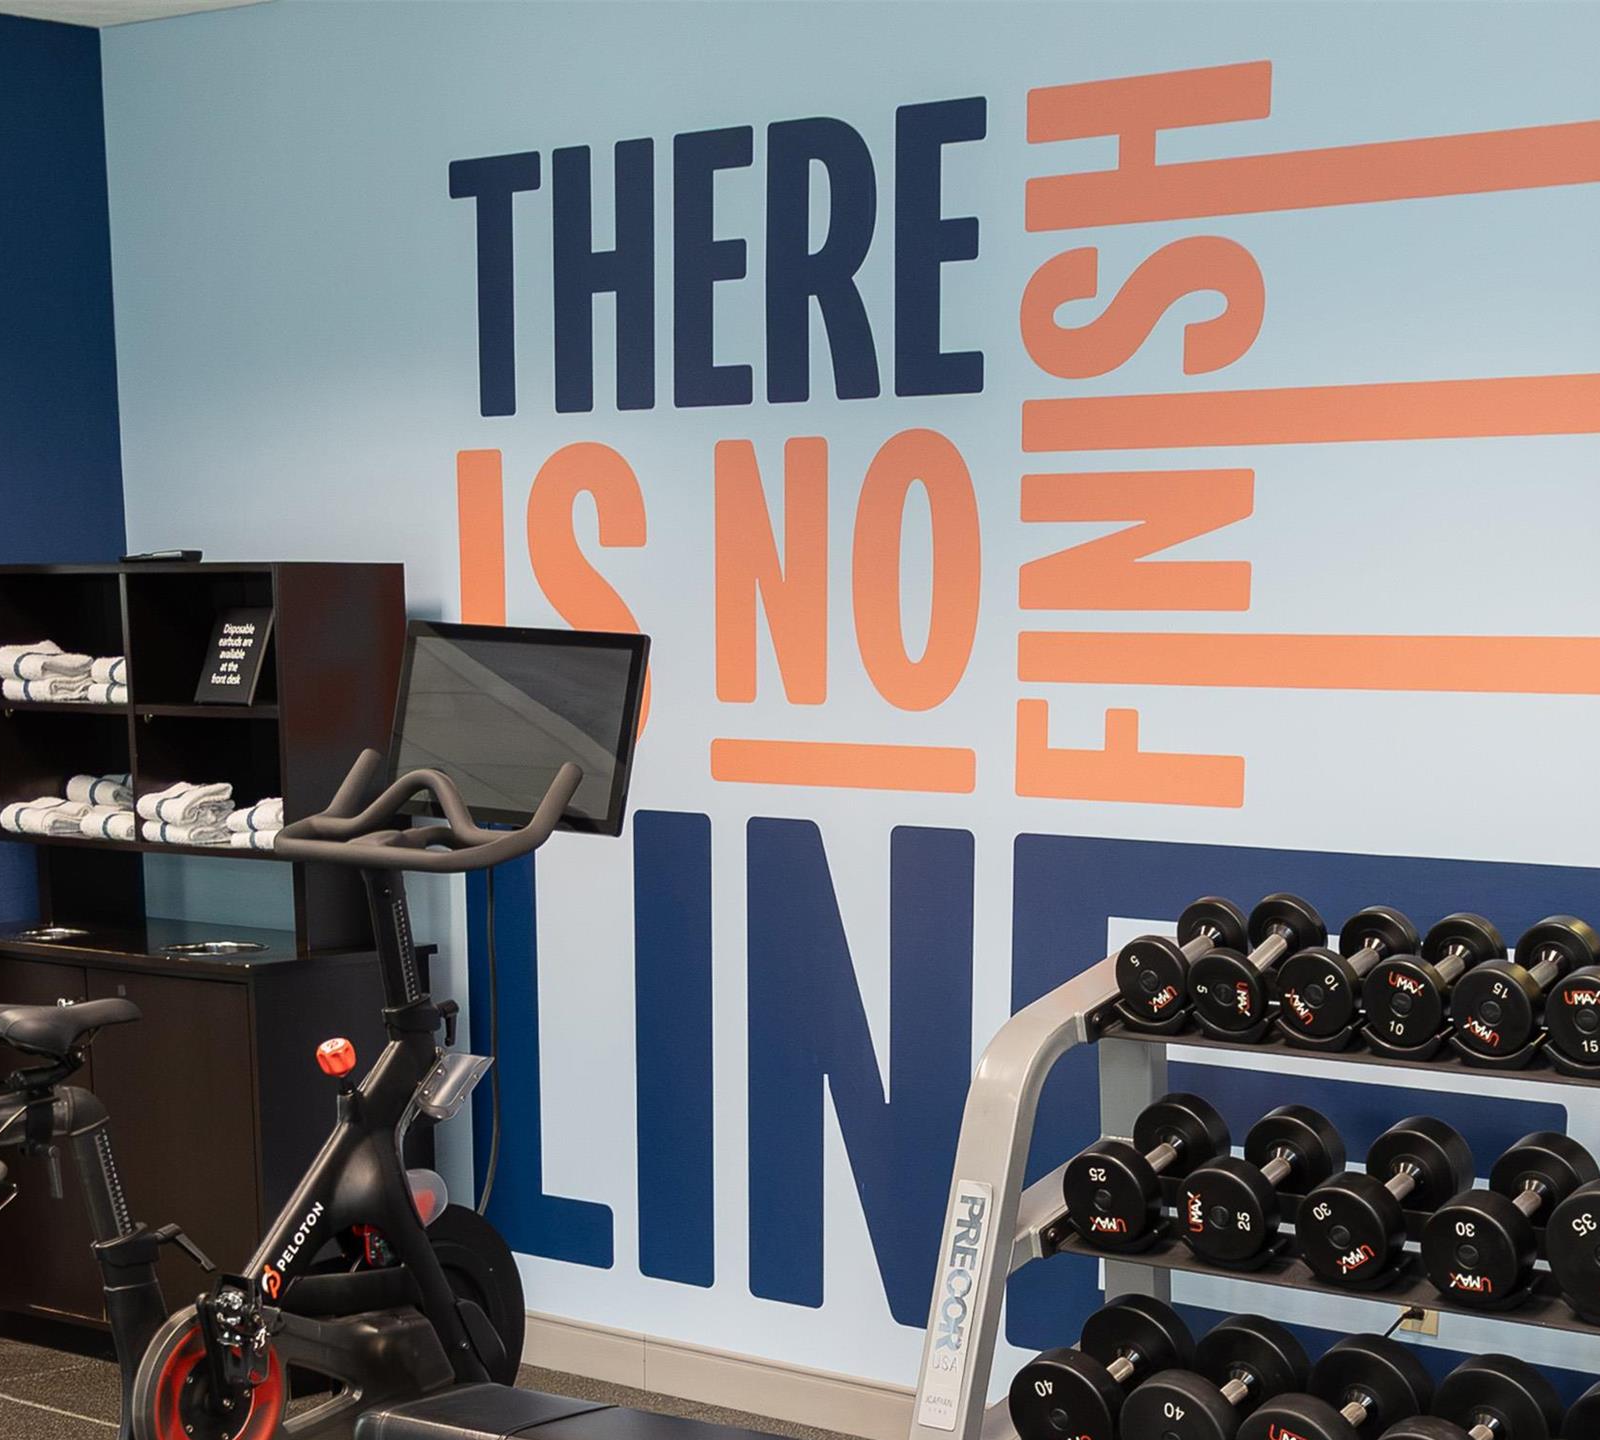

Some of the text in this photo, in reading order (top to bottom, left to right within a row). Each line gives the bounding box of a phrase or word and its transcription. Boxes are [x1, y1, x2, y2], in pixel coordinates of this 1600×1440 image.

[448, 96, 988, 418] THERE
[1014, 58, 1273, 809] FINISH
[456, 427, 982, 746] IS NO
[223, 623, 255, 636] Disposable
[218, 636, 254, 647] earbuds are
[219, 648, 246, 660] available
[219, 661, 239, 672] at the
[211, 673, 241, 685] front desk
[1130, 955, 1140, 967] 5
[1196, 984, 1208, 994] 5
[1324, 969, 1344, 991] 10
[1388, 971, 1425, 997] UMAX
[1492, 977, 1515, 999] 15
[1148, 985, 1177, 1013] UMAX
[1236, 982, 1251, 1017] UMAX
[1284, 988, 1314, 1026] UMAX
[1390, 1020, 1404, 1036] 10
[1458, 1017, 1500, 1052] UMAX
[1581, 1040, 1599, 1053] 15
[1088, 1167, 1107, 1182] 25
[1187, 1191, 1203, 1233] UMAX
[1236, 1211, 1251, 1232] 25
[1312, 1202, 1332, 1221] 30
[1090, 1216, 1127, 1232] UMAX
[1455, 1221, 1475, 1238] 30
[1571, 1213, 1597, 1237] 35
[276, 1201, 324, 1272] PELOTON
[1336, 1244, 1375, 1275] UMAX
[933, 1194, 986, 1351] PRECOR
[1449, 1273, 1492, 1292] UMAX
[1034, 1379, 1053, 1397] 40
[1163, 1402, 1185, 1421] 40
